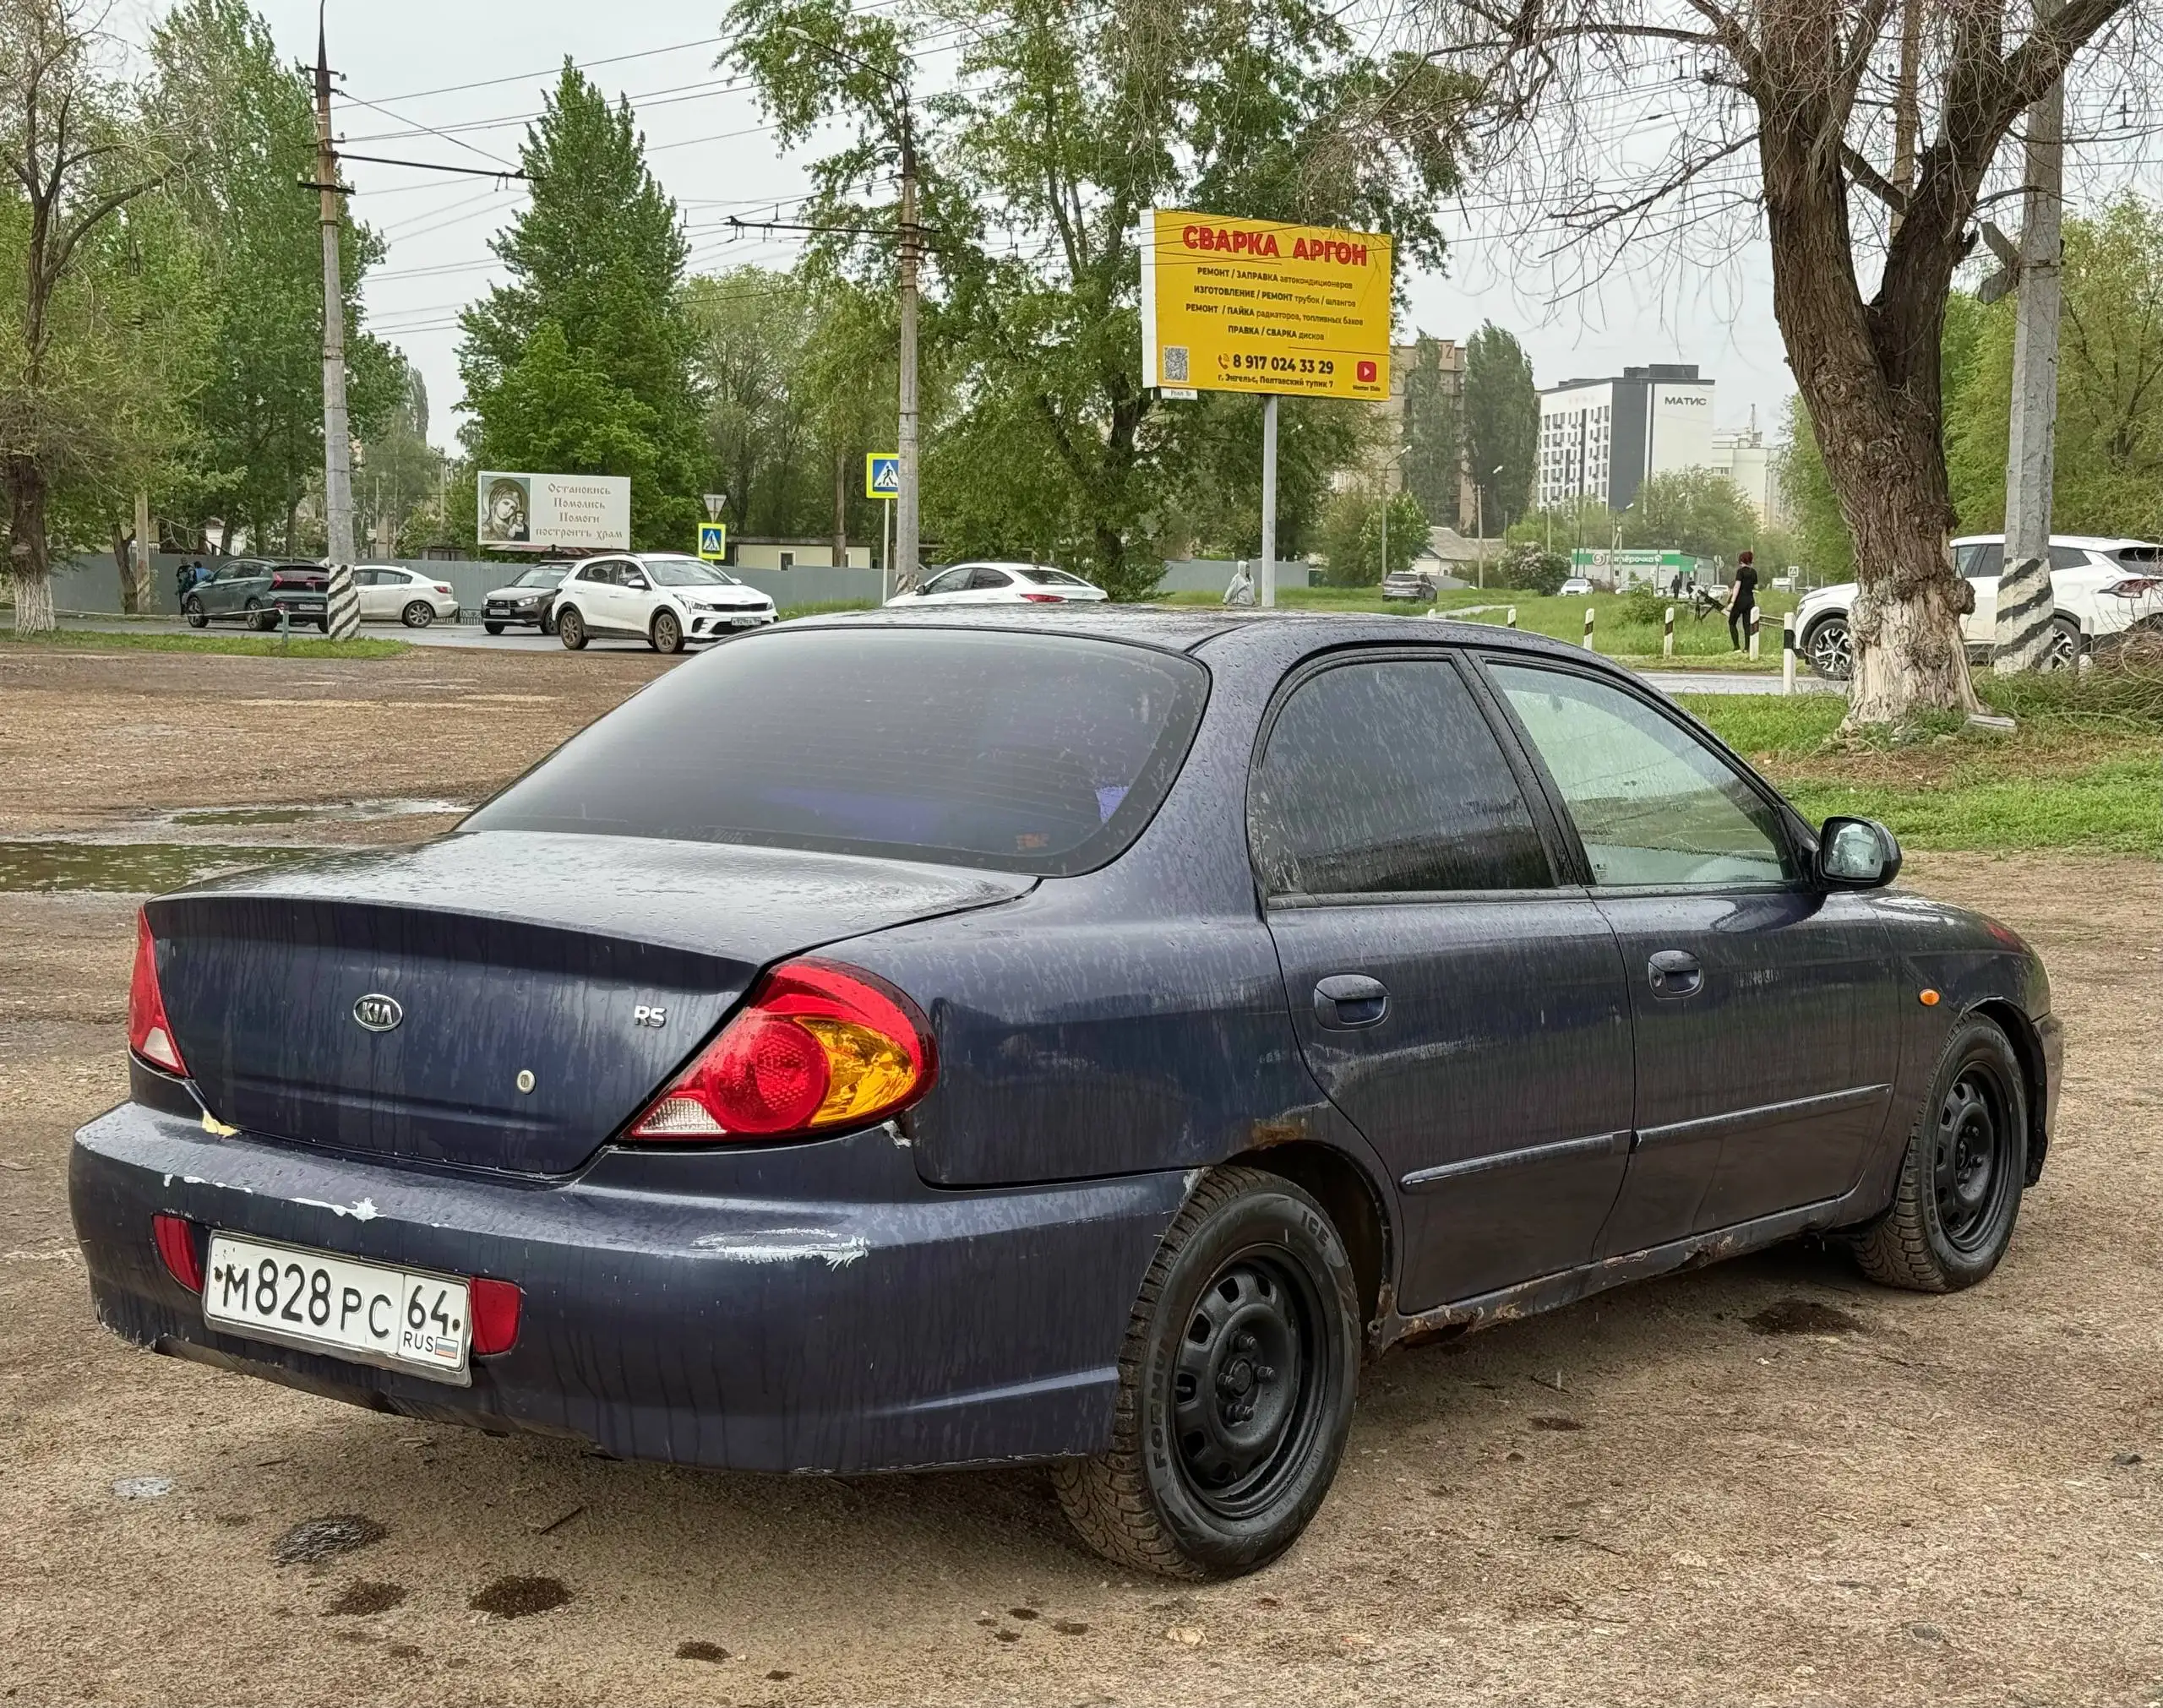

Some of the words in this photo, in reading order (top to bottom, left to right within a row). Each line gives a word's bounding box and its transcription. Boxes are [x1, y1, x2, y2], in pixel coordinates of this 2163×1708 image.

[1183, 226, 1280, 258] СВАРКА
[1293, 237, 1367, 266] АРГОН
[1197, 267, 1229, 277] РЕМОНТ
[1237, 270, 1278, 282] ЗАПРАВКА
[1280, 276, 1353, 290] автокондиционеров
[1194, 286, 1256, 297] ИЗГОТОВЛЕНИЕ
[1261, 291, 1293, 302] РЕМОНТ
[1294, 295, 1320, 304] трубок
[1326, 299, 1356, 307] шлангов
[1185, 303, 1218, 313] РЕМОНТ
[1227, 306, 1255, 317] ПАЙКА
[1229, 325, 1260, 335] ПРАВКА
[1267, 328, 1297, 338] СВАРКА
[1299, 332, 1325, 340] дисков
[1233, 354, 1241, 368] 8
[1245, 355, 1267, 370] 917
[1271, 356, 1296, 372] 024
[1299, 359, 1315, 373] 33
[1318, 360, 1334, 374] 29
[1260, 376, 1304, 386] Полтавский
[1305, 380, 1327, 389] тупик
[1664, 396, 1707, 405] МАТИС
[548, 482, 612, 495] Остановись
[553, 498, 606, 509] Помолись
[559, 512, 600, 523] Помоги
[536, 528, 592, 539] построить
[596, 530, 623, 541] храм
[1606, 554, 1654, 564] тёрочка
[361, 1001, 393, 1025] KIA
[634, 1004, 667, 1028] RS
[1300, 1210, 1330, 1248] ICE
[407, 1284, 449, 1336] 64
[403, 1330, 434, 1352] RUS
